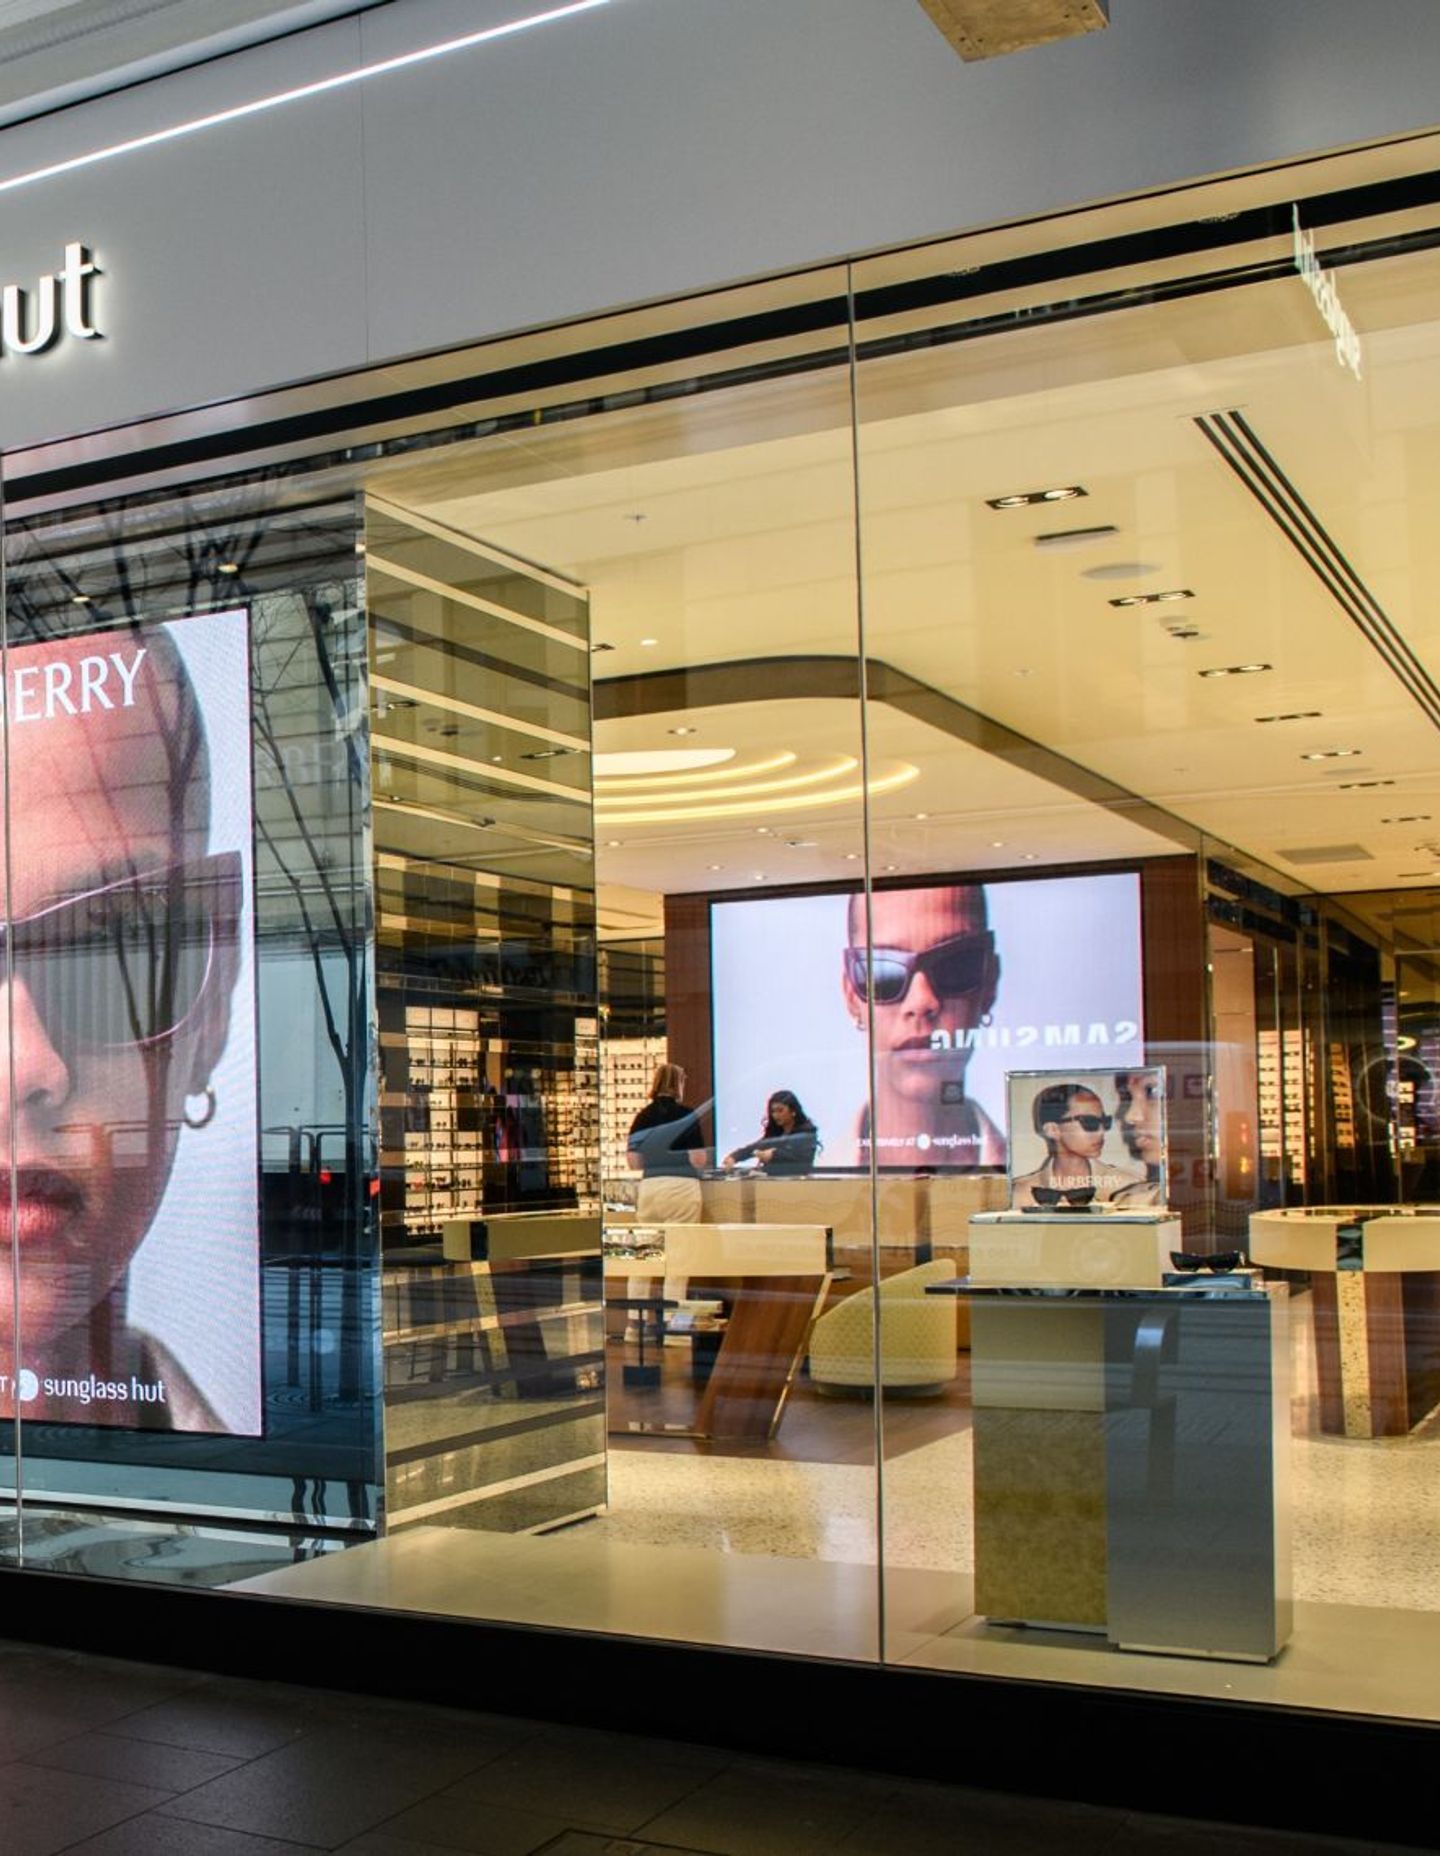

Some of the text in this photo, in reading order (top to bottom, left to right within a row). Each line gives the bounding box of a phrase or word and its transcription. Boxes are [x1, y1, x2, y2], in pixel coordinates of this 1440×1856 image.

[1049, 1175, 1122, 1188] BURBERRY
[44, 1373, 128, 1405] sunglass
[131, 1376, 166, 1403] hut
